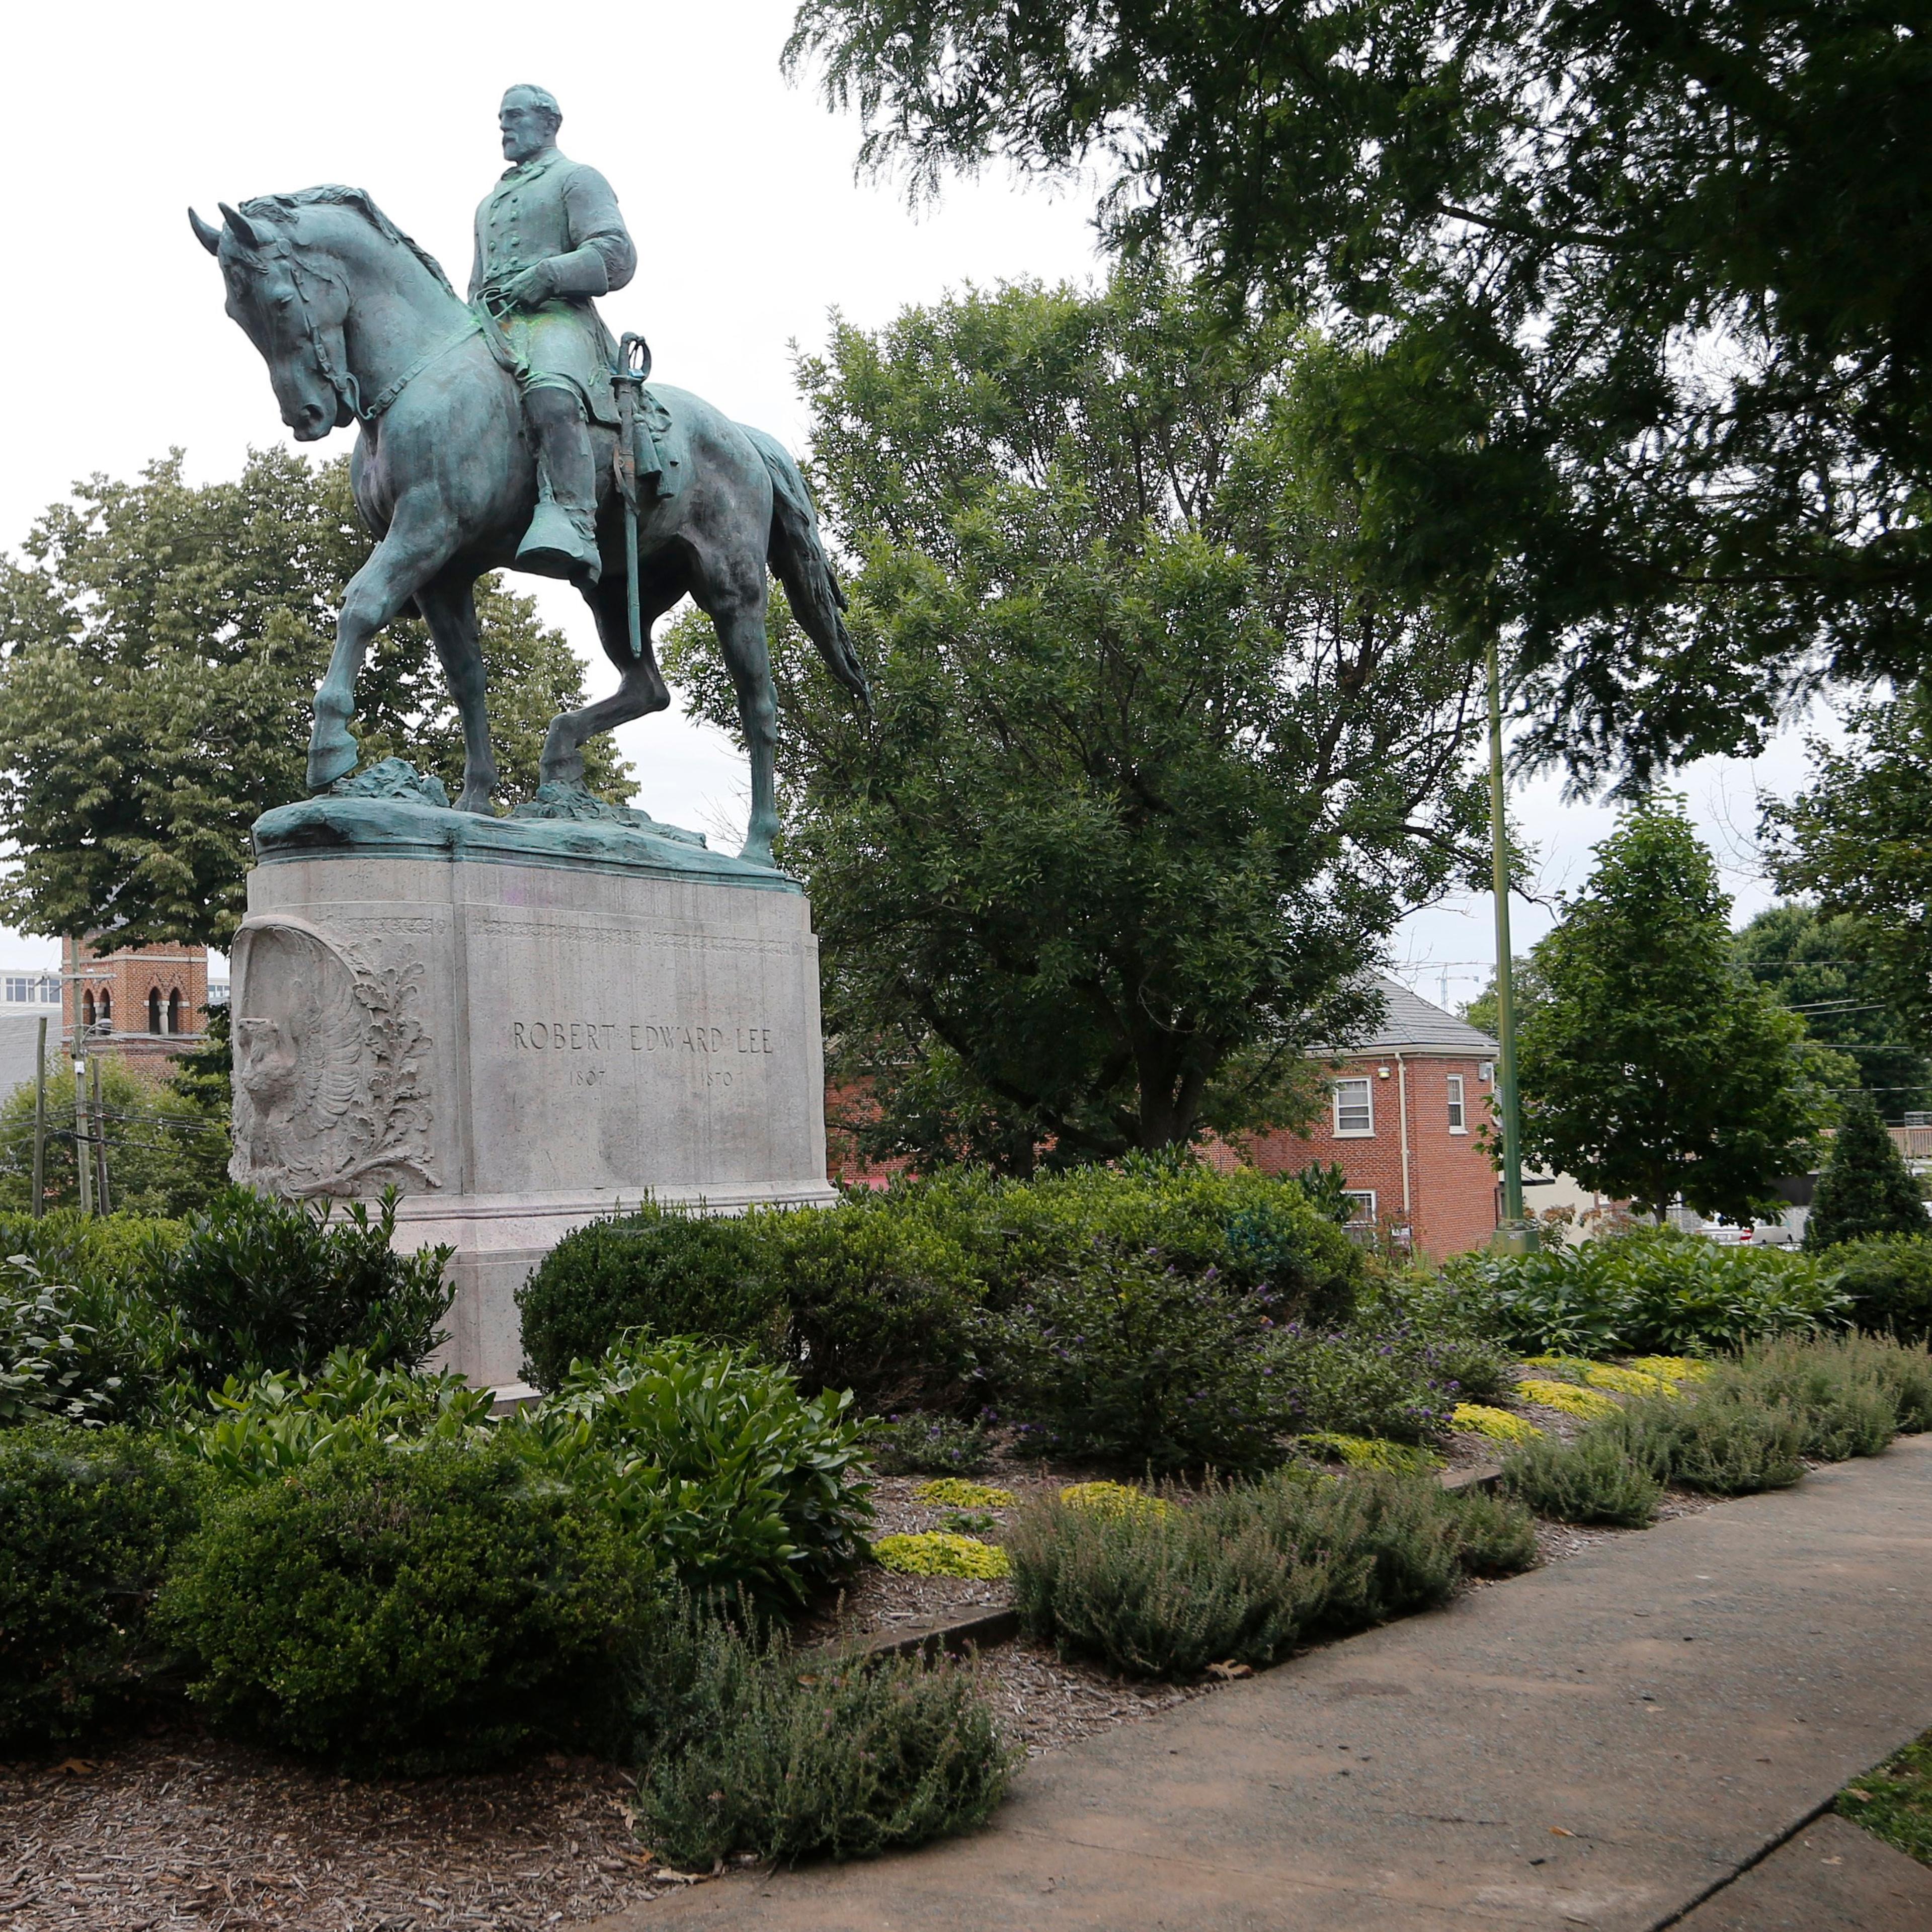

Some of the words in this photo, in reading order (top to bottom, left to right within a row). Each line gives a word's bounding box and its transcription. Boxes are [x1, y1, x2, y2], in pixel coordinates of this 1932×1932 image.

[513, 1022, 615, 1051] ROBERT
[629, 1025, 722, 1053] EDWARD
[737, 1028, 773, 1054] LEE
[570, 1070, 605, 1086] 1807
[701, 1072, 733, 1086] 1870
